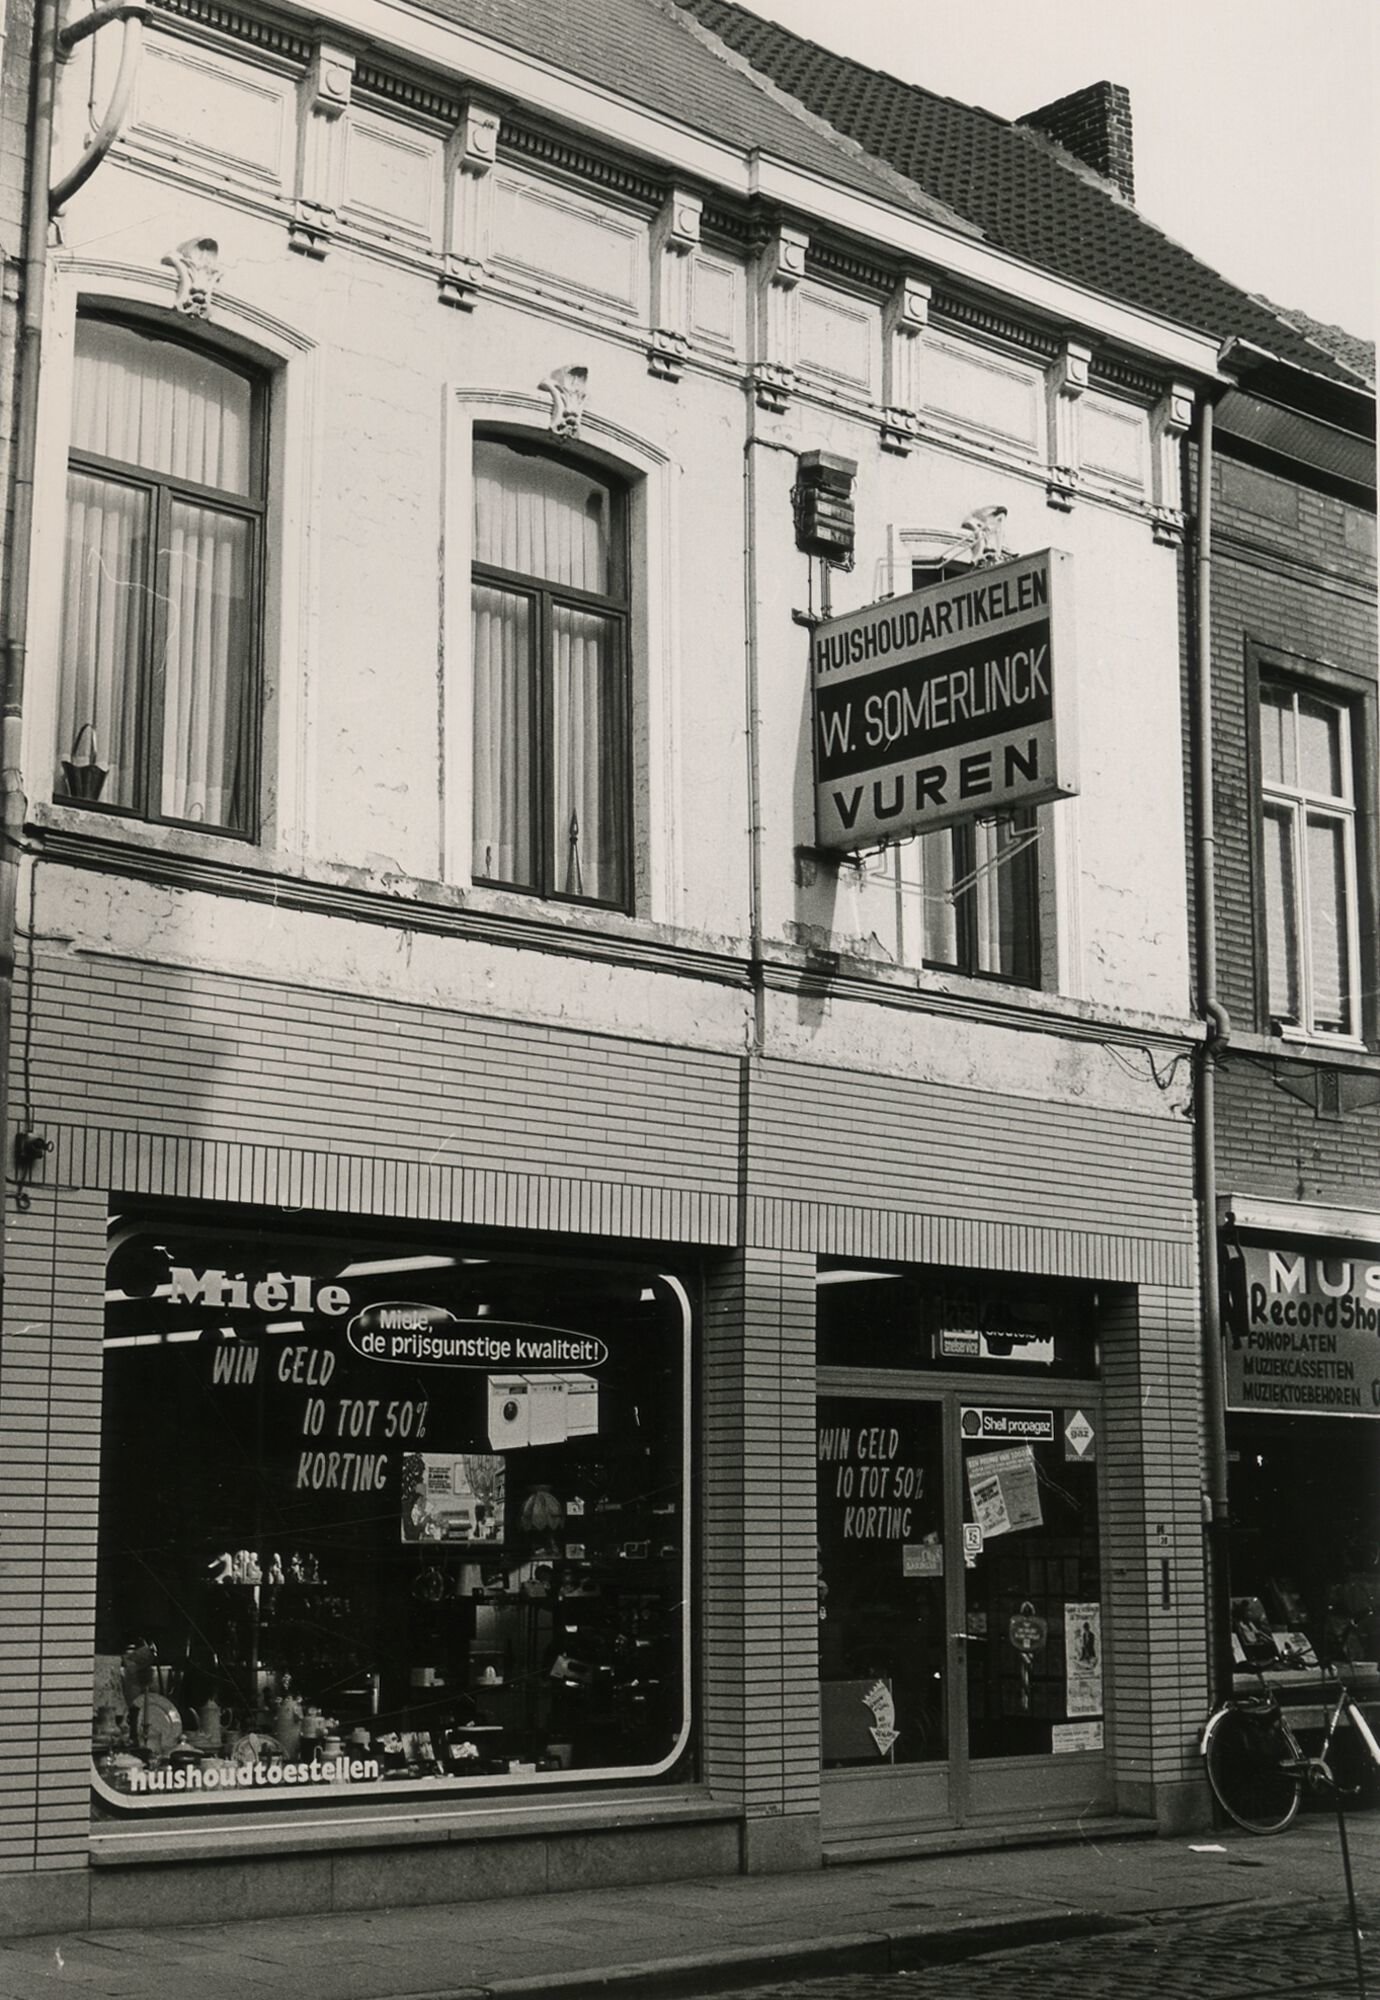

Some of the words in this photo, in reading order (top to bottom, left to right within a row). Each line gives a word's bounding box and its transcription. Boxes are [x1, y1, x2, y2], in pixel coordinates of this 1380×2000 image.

[816, 567, 1048, 675] HUISHOUDARTIKELEN
[820, 702, 856, 758] W.
[864, 643, 1050, 748] SOMERLINCK
[832, 737, 1039, 831] VUREN
[167, 1266, 351, 1316] Miele
[379, 1309, 434, 1333] Miele,
[361, 1332, 386, 1354] de
[391, 1334, 511, 1361] prijsgunstige
[516, 1338, 600, 1361] kwaliteit!
[212, 1346, 259, 1384] WIN
[277, 1346, 336, 1387] GELD
[1243, 1355, 1355, 1380] MUZIEKCASSETTEN
[1243, 1381, 1361, 1406] MUZIEKTOEBEHOREN
[303, 1398, 326, 1436] 10
[337, 1399, 380, 1437] TOT
[384, 1401, 428, 1438] 50%
[983, 1416, 1007, 1431] Shell
[1008, 1420, 1051, 1436] propagaz
[1070, 1430, 1090, 1440] gaz
[818, 1427, 851, 1460] WIN
[857, 1427, 899, 1460] GELD
[296, 1451, 389, 1492] KORTING
[836, 1465, 854, 1499] 10
[860, 1466, 891, 1499] TOT
[893, 1466, 924, 1500] 50%
[843, 1505, 912, 1540] KORTING
[129, 1756, 379, 1791] huishoudtoestellen
